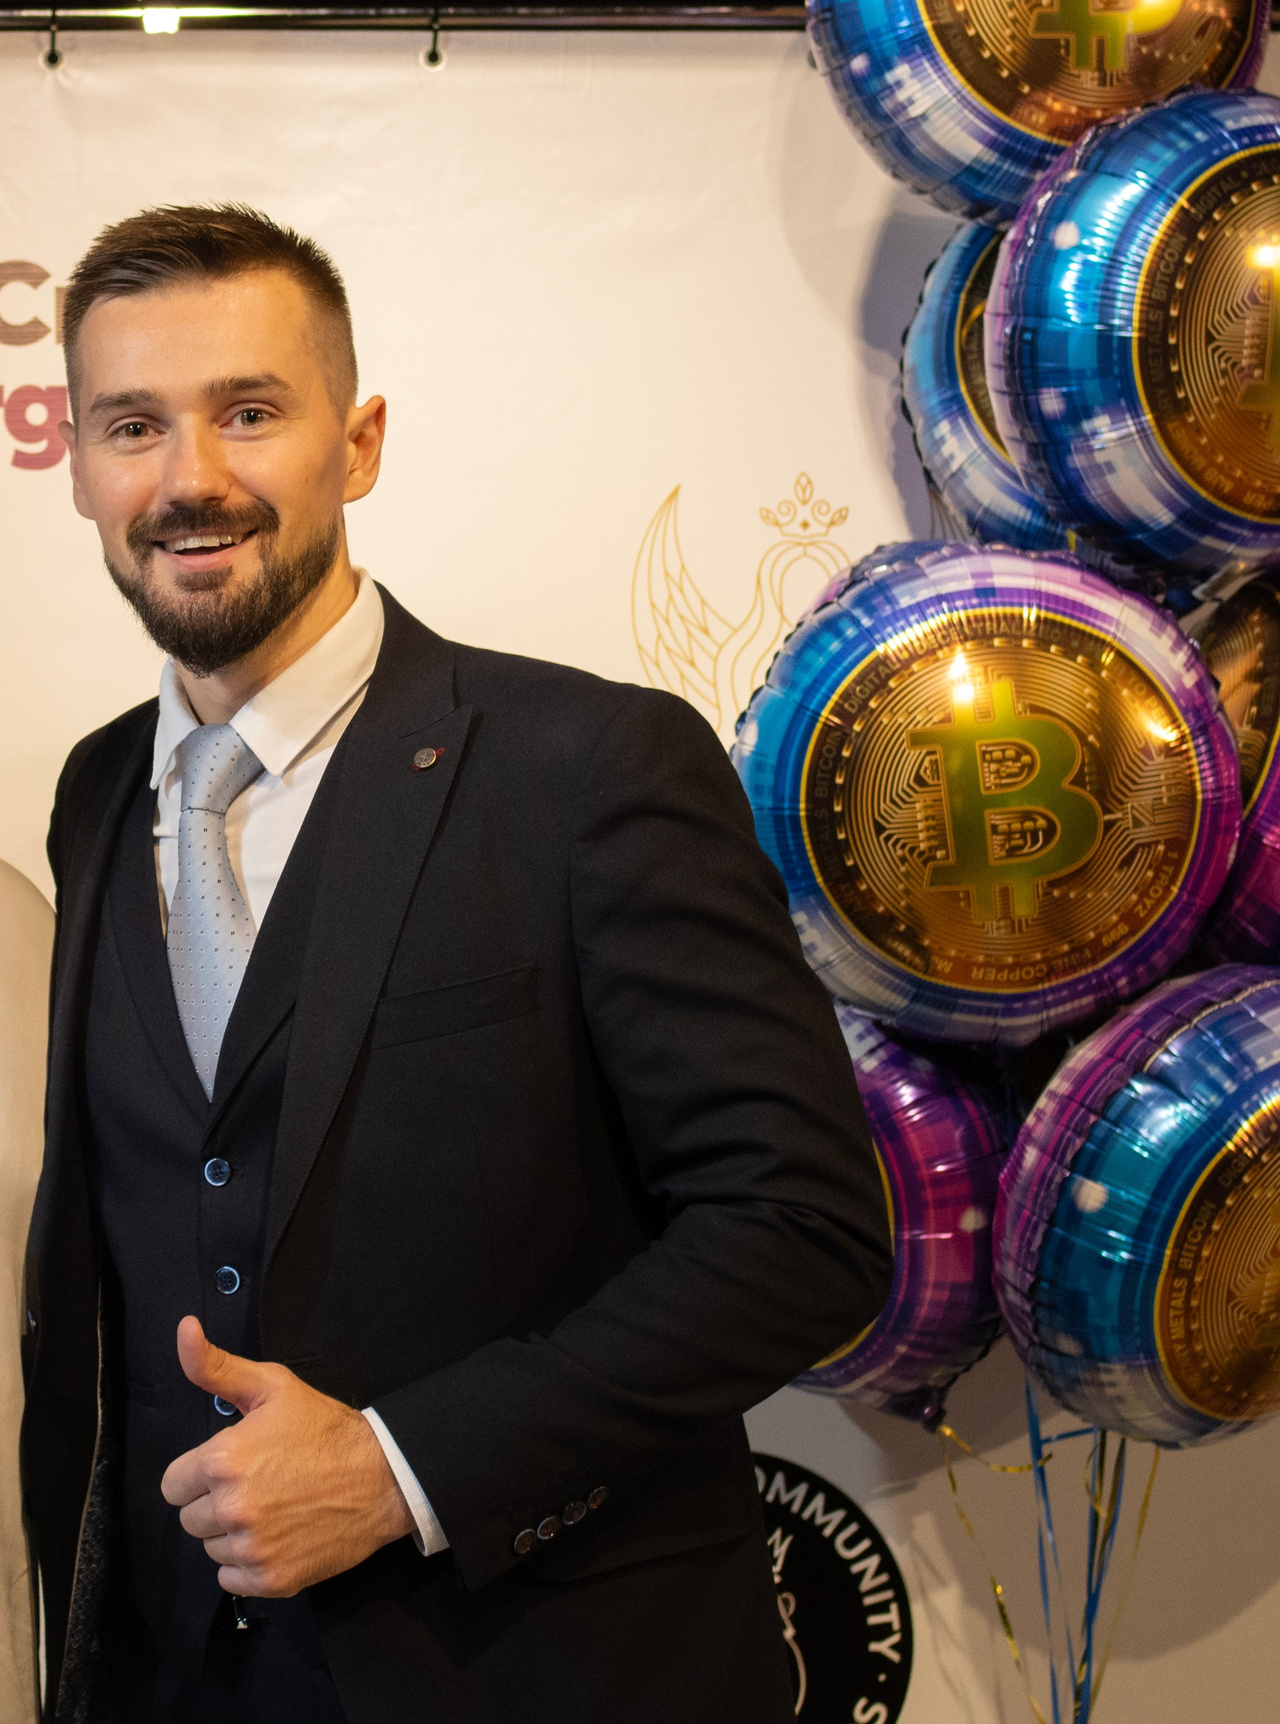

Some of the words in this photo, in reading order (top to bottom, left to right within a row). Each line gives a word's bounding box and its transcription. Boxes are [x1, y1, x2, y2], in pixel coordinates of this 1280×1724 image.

[841, 653, 901, 713] DIGITAL
[1098, 920, 1132, 949] 999
[969, 960, 1050, 981] COPPER
[1178, 1202, 1216, 1270] BITCOIN
